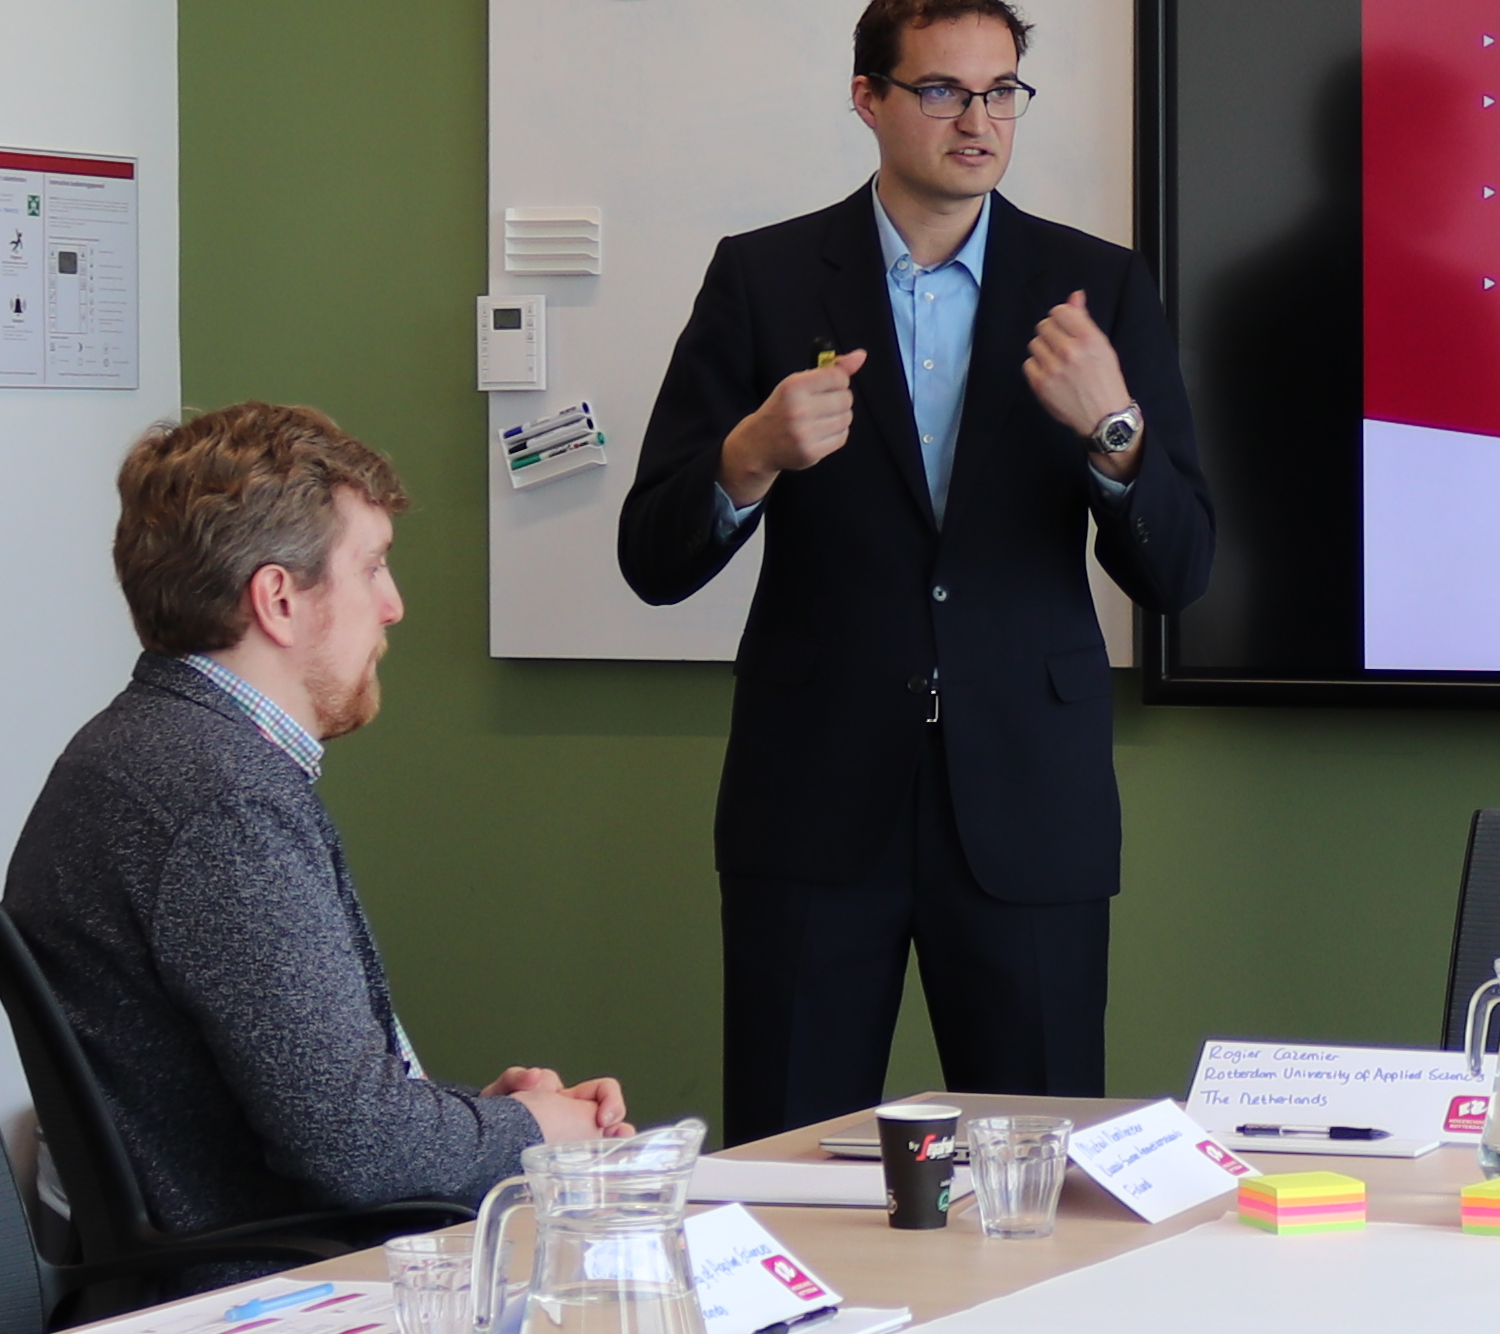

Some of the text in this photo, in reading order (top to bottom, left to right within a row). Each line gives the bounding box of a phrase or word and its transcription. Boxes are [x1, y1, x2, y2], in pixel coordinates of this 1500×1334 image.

[1208, 1045, 1262, 1063] Rogier
[1204, 1067, 1278, 1082] Rotterdam
[1283, 1067, 1351, 1086] University
[1354, 1069, 1371, 1082] of
[1373, 1068, 1422, 1083] Applied
[1200, 1089, 1329, 1108] The Netherlands
